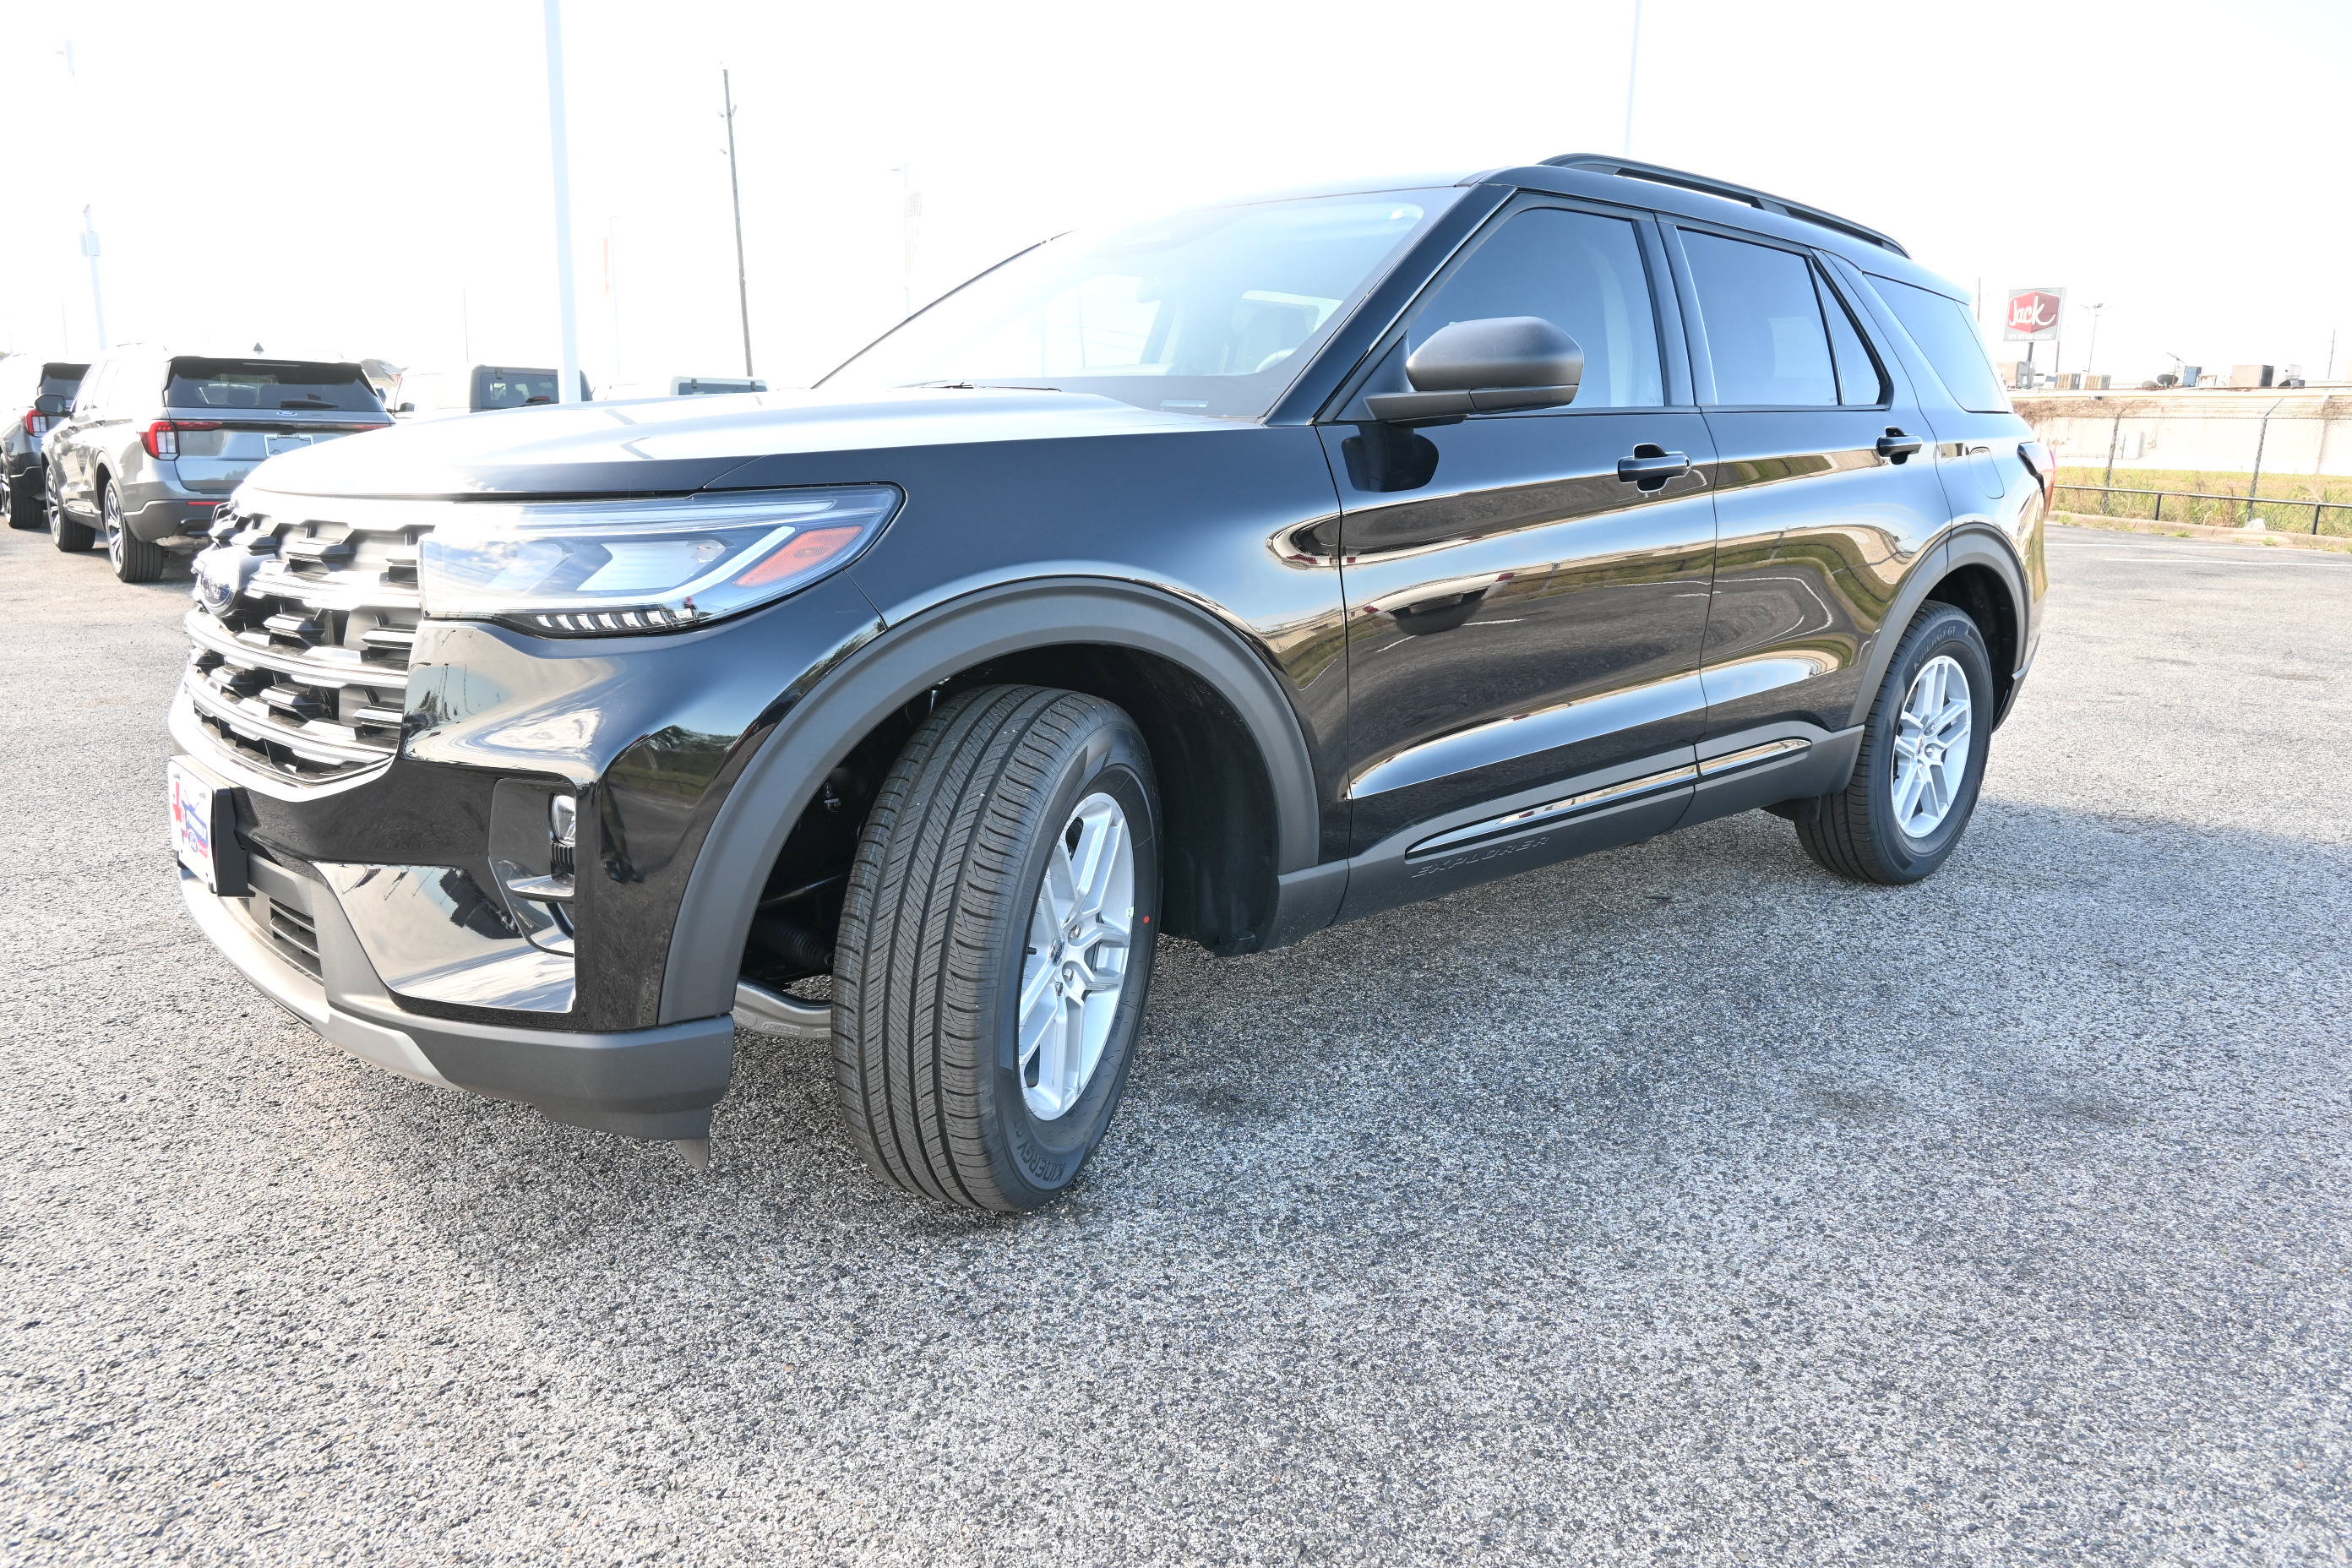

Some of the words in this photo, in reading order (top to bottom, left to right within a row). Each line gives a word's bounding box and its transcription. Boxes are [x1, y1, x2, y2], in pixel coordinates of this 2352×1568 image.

[2008, 295, 2055, 326] Jack
[1411, 836, 1549, 878] EXPLORER
[1017, 1141, 1065, 1182] KINERGY
